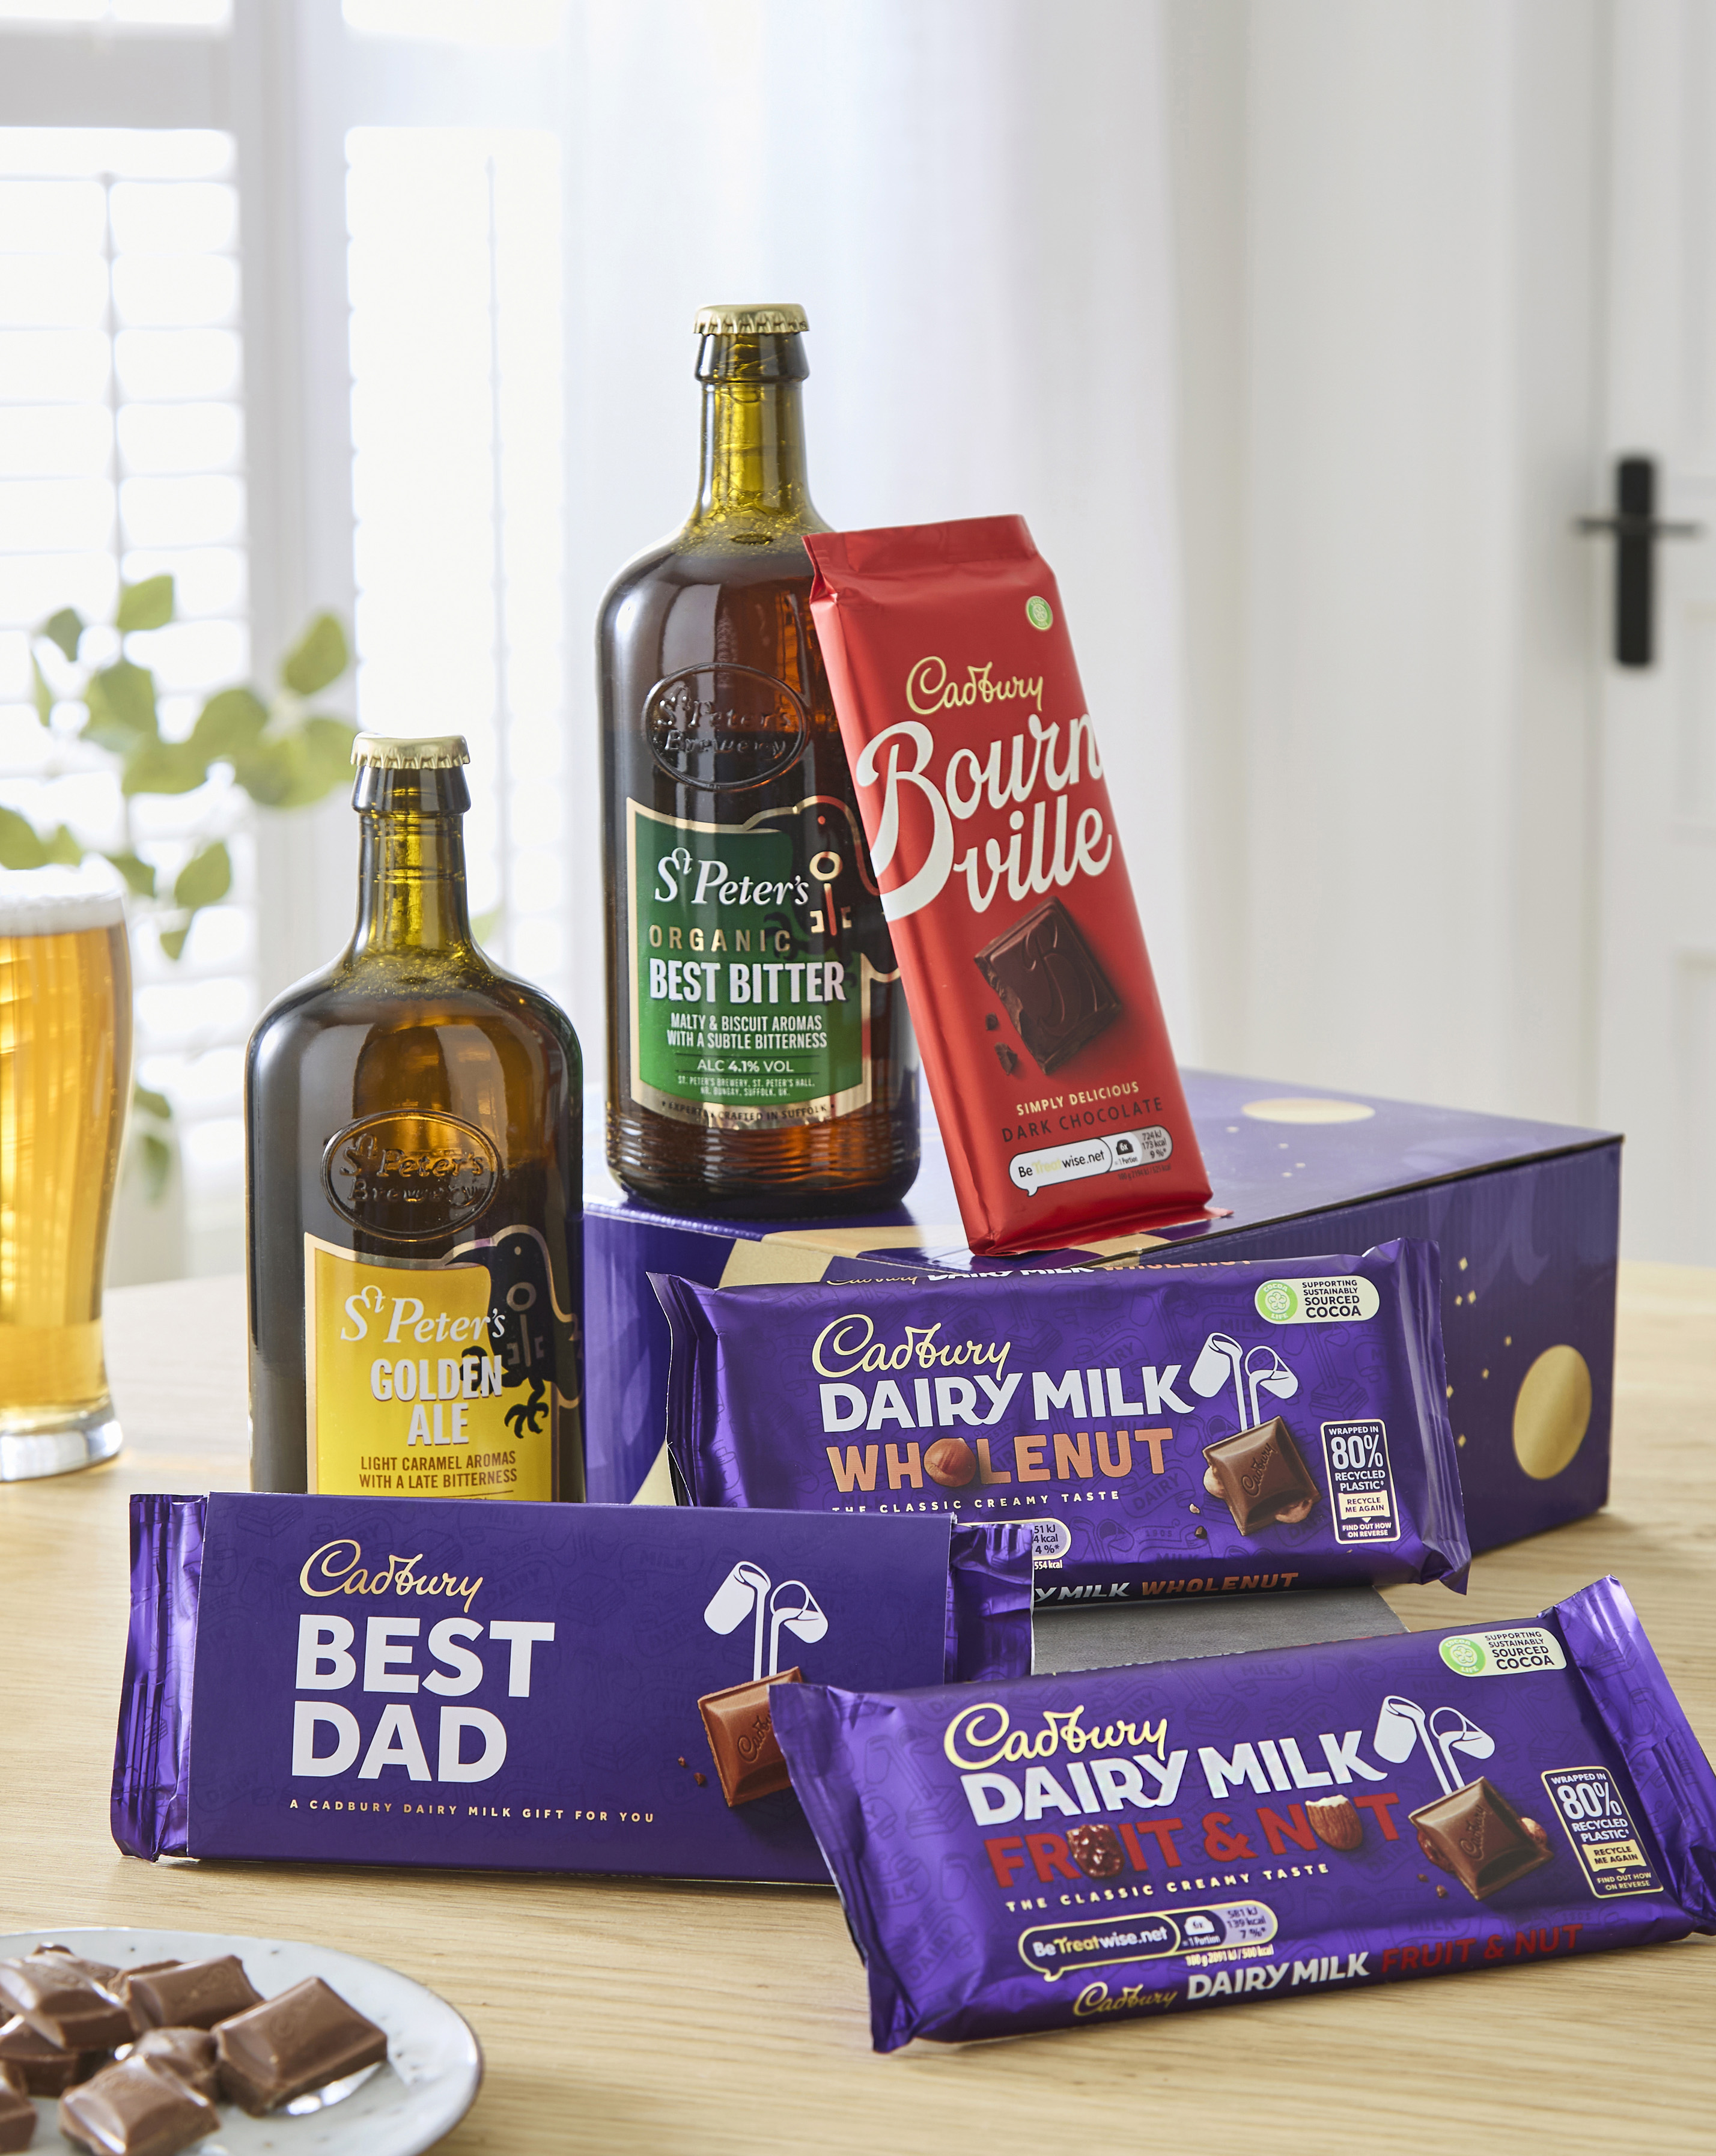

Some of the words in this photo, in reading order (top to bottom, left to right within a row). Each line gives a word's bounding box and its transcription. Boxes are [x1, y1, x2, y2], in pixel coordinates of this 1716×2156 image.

[907, 656, 1043, 715] Cadbury
[856, 713, 1104, 922] Bourn
[953, 794, 1112, 914] ville
[691, 860, 809, 905] Peter's
[649, 925, 791, 953] ORGANIC
[649, 958, 721, 1003] BEST
[729, 961, 846, 1003] BITTER
[671, 1013, 705, 1030] MALTY
[709, 1015, 718, 1030] &
[722, 1016, 767, 1031] BISCUIT
[772, 1015, 823, 1031] AROMAS
[667, 1030, 693, 1046] WITH
[696, 1031, 705, 1047] A
[707, 1033, 751, 1049] SUBTLE
[755, 1032, 827, 1049] BITTERNESS
[697, 1060, 725, 1071] ALC
[728, 1060, 759, 1072] 4.1%
[763, 1060, 794, 1072] VOL
[1017, 1096, 1063, 1116] SIMPLY
[1069, 1081, 1140, 1105] DELICIOUS
[767, 1111, 779, 1120] IN
[1002, 1119, 1053, 1142] DARK
[1059, 1097, 1163, 1131] CHOCOLATE
[1122, 1156, 1139, 1164] Portion
[1264, 1283, 1288, 1293] COCOA
[1303, 1287, 1358, 1296] SUSTAINABLY
[1304, 1295, 1360, 1306] SOURCED
[1306, 1305, 1362, 1318] COCOA
[383, 1297, 506, 1343] Peter's
[812, 1314, 1011, 1380] Cadbury
[371, 1355, 502, 1401] GOLDEN
[819, 1373, 1023, 1432] DAIRY
[1032, 1364, 1194, 1421] MILK
[407, 1403, 469, 1446] ALE
[1328, 1426, 1368, 1436] WRAPPED
[361, 1456, 398, 1471] LIGHT
[403, 1456, 462, 1471] CARAMEL
[466, 1451, 516, 1469] AROMAS
[1331, 1435, 1384, 1470] 80%
[359, 1474, 394, 1488] WITH
[397, 1475, 404, 1489] A
[409, 1474, 438, 1488] LATE
[443, 1468, 517, 1487] BITTERNESS
[1241, 1442, 1279, 1498] Cadbury
[1335, 1470, 1386, 1481] RECYCLED
[880, 1499, 962, 1513] CLASSIC
[975, 1495, 1048, 1508] CREAMY
[1062, 1490, 1119, 1502] TASTE
[1358, 1504, 1384, 1513] AGAIN
[1041, 1534, 1058, 1543] kcal
[1046, 1524, 1056, 1533] kJ
[1360, 1529, 1389, 1538] REVERSE
[1034, 1561, 1047, 1570] 554
[1048, 1559, 1063, 1569] kcal
[300, 1539, 484, 1613] Cadbury
[1057, 1582, 1131, 1600] MILK
[1142, 1572, 1299, 1596] WHOLENUT
[1485, 1632, 1542, 1641] SUPPORTING
[1488, 1638, 1544, 1648] SUSTAINABLY
[295, 1614, 555, 1698] BEST
[1492, 1645, 1548, 1657] SOURCED
[1496, 1655, 1555, 1670] COCOA
[291, 1701, 507, 1783] DAD
[737, 1711, 771, 1763] Cadbu
[944, 1702, 1168, 1770] Cadbury
[960, 1749, 1188, 1826] DAIRY
[1198, 1730, 1388, 1799] MILK
[1551, 1774, 1595, 1784] WRAPPED
[290, 1799, 298, 1808] A
[309, 1800, 392, 1812] CADBURY
[404, 1804, 457, 1815] DAIRY
[469, 1806, 511, 1817] MILK
[523, 1808, 564, 1820] GIFT
[575, 1811, 607, 1821] FOR
[619, 1812, 654, 1823] YOU
[1557, 1782, 1622, 1820] 80%
[1571, 1818, 1628, 1832] RECYCLED
[1202, 1812, 1258, 1862] &
[1593, 1846, 1632, 1856] RECYCLE
[1610, 1854, 1638, 1863] AGAIN
[1006, 1896, 1047, 1912] THE
[1060, 1884, 1153, 1905] CLASSIC
[1166, 1873, 1250, 1892] CREAMY
[1262, 1863, 1330, 1880] TASTE
[1619, 1880, 1651, 1889] REVERSE
[1194, 1935, 1221, 1946] Portion
[1073, 1981, 1179, 2016] Cadbury
[1186, 1961, 1291, 2000] DAIRY
[1292, 1952, 1370, 1985] MILK
[1381, 1938, 1475, 1972] FRUIT
[1483, 1935, 1505, 1958] &
[1515, 1924, 1584, 1955] NUT
